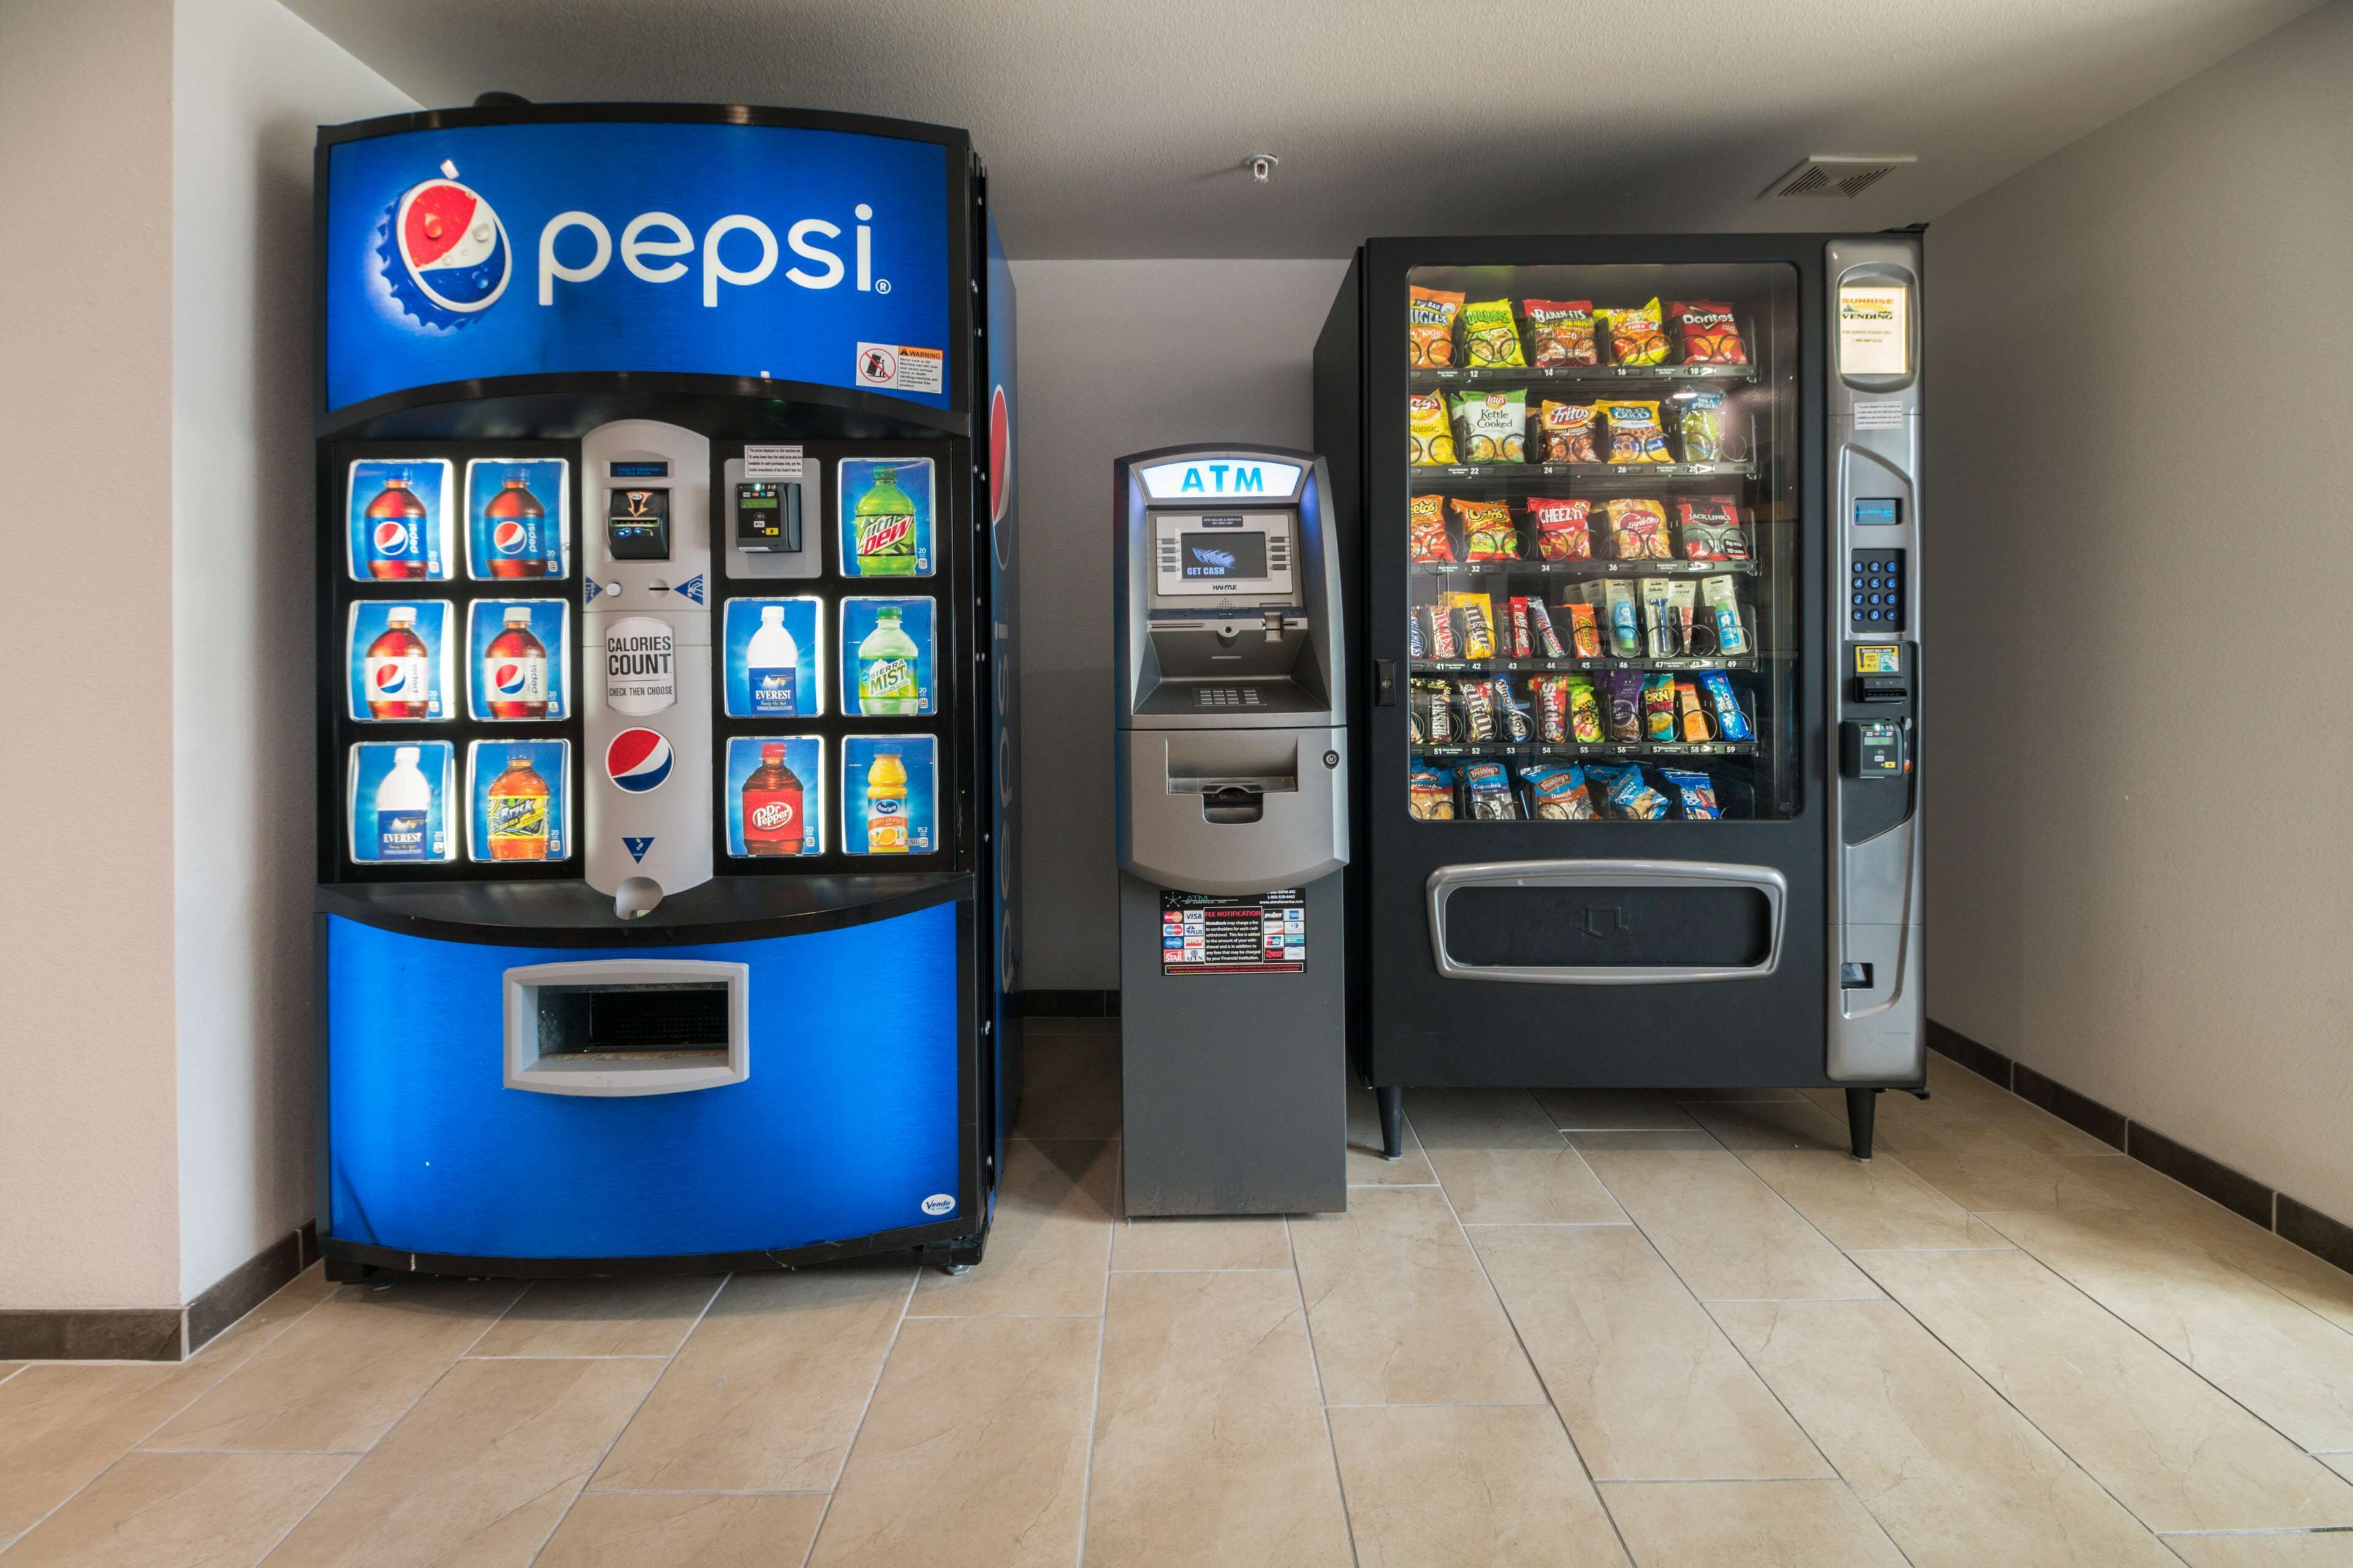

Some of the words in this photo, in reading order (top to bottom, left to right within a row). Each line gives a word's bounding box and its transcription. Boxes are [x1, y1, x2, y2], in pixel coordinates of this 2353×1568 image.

[538, 202, 873, 308] pepsi
[1427, 301, 1440, 310] BAG
[1682, 313, 1735, 325] Doritos
[910, 350, 941, 359] WARNING
[1486, 395, 1506, 405] Lay's
[1481, 409, 1508, 420] Kettle
[1552, 406, 1589, 424] Fritos
[1477, 419, 1513, 428] Cooked
[1180, 465, 1264, 493] ATM
[408, 523, 420, 554] pepsi
[526, 523, 538, 553] pepsi
[607, 636, 671, 653] CALORIES
[609, 654, 671, 676] COUNT
[870, 659, 904, 680] SIERRA
[870, 665, 906, 695] MIST
[609, 687, 627, 697] CHECK
[629, 686, 645, 696] THEN
[647, 686, 673, 695] CHOOSE
[755, 690, 791, 700] EVEREST
[1541, 682, 1559, 740] Skittles
[756, 808, 790, 827] Pepper
[766, 805, 781, 816] Dr
[382, 832, 422, 843] EVEREST
[926, 1200, 951, 1210] Vendo
